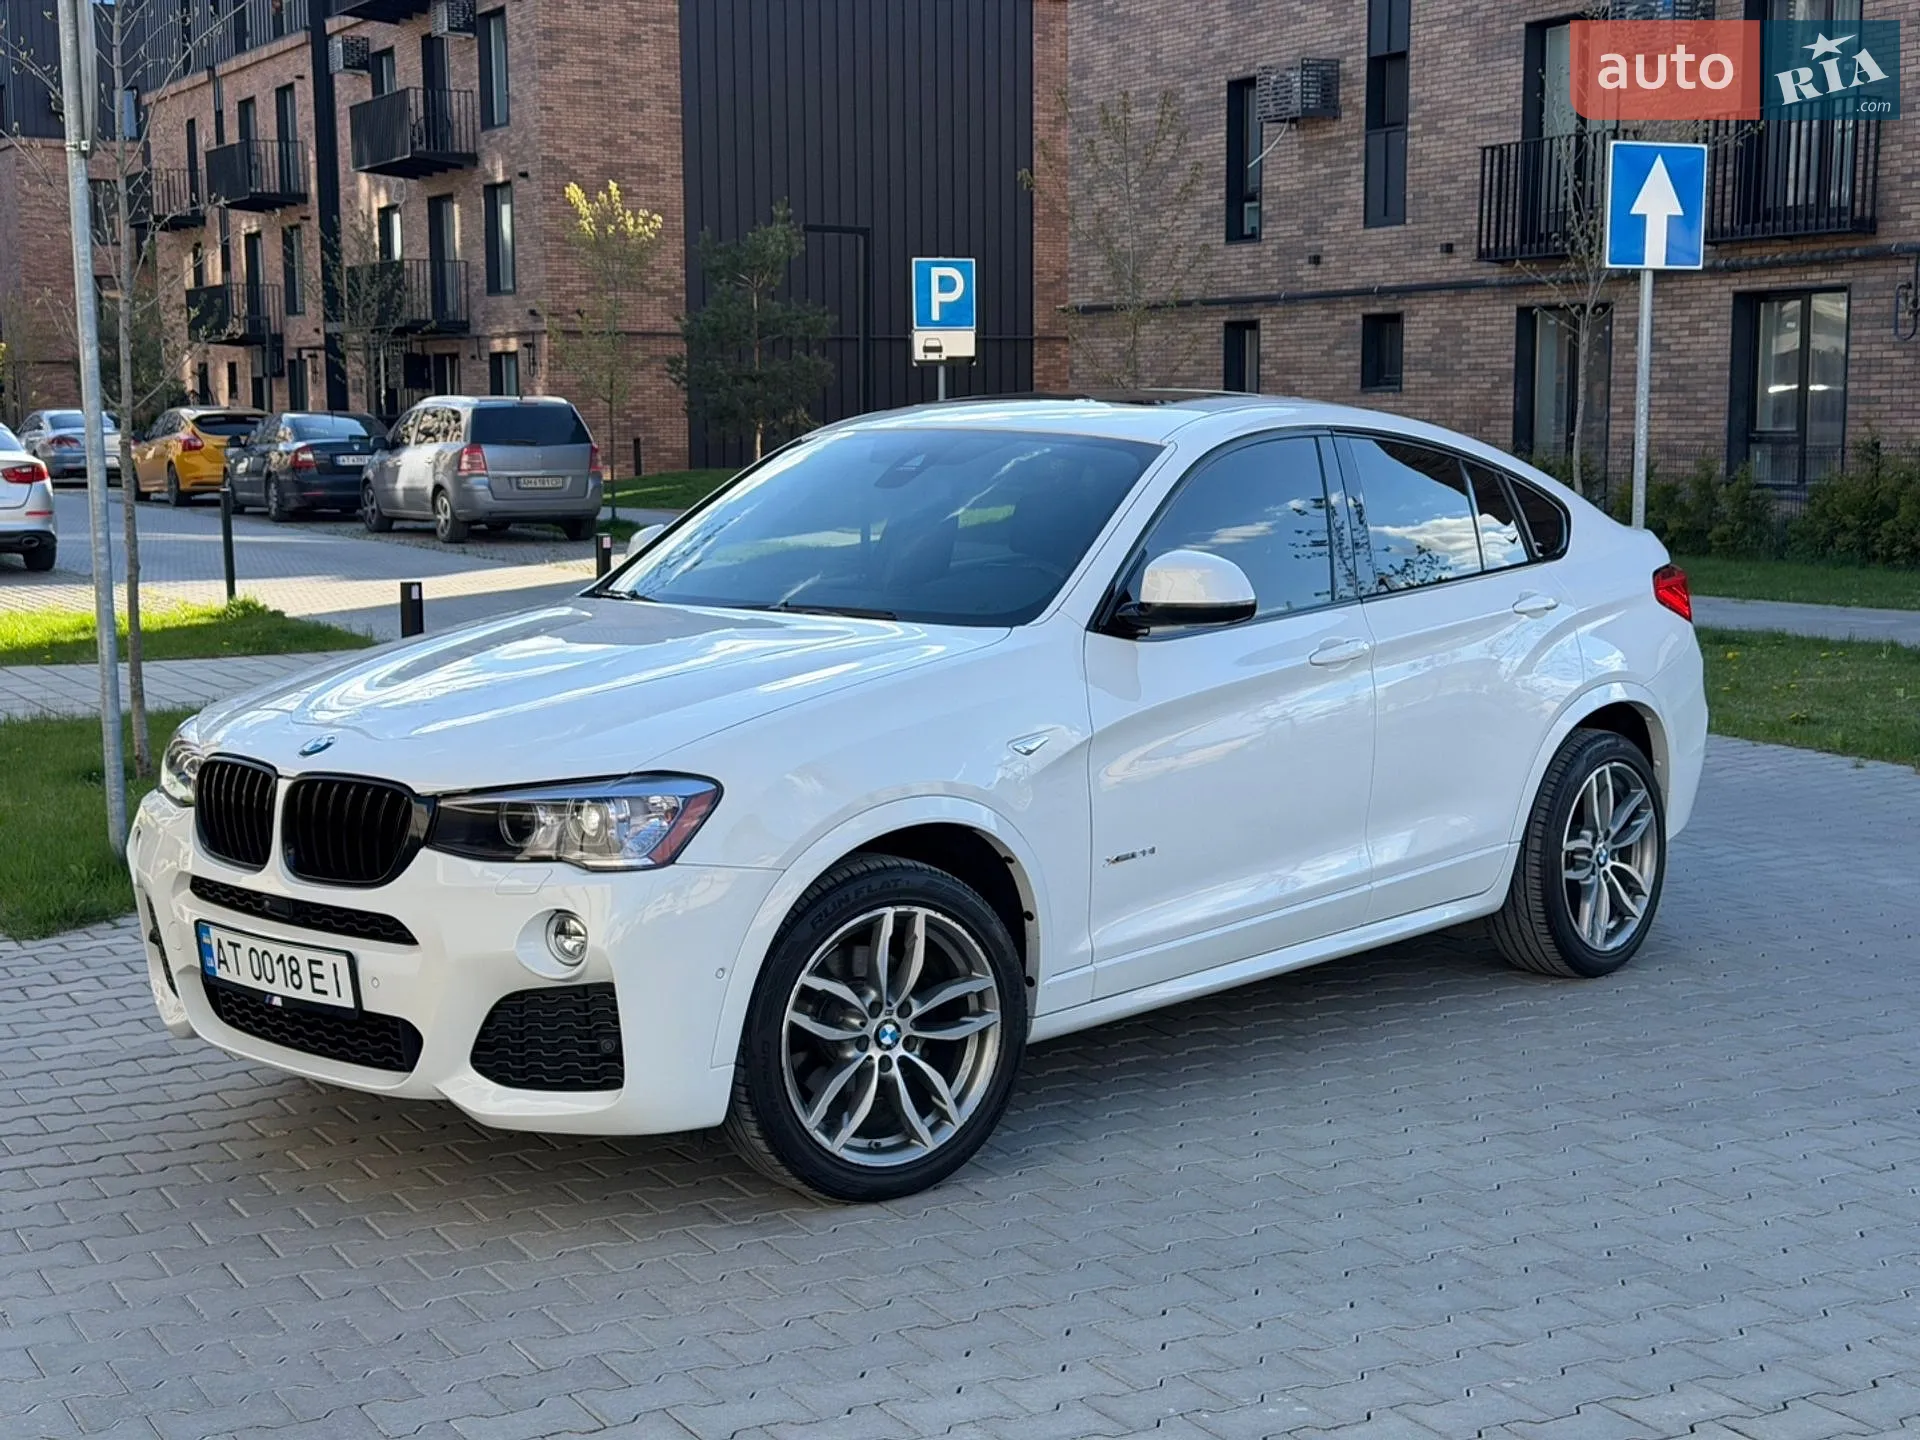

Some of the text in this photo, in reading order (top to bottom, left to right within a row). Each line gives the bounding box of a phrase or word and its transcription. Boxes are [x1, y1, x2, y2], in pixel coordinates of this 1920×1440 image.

[931, 267, 964, 321] P
[217, 938, 342, 998] AT 0018 EI
